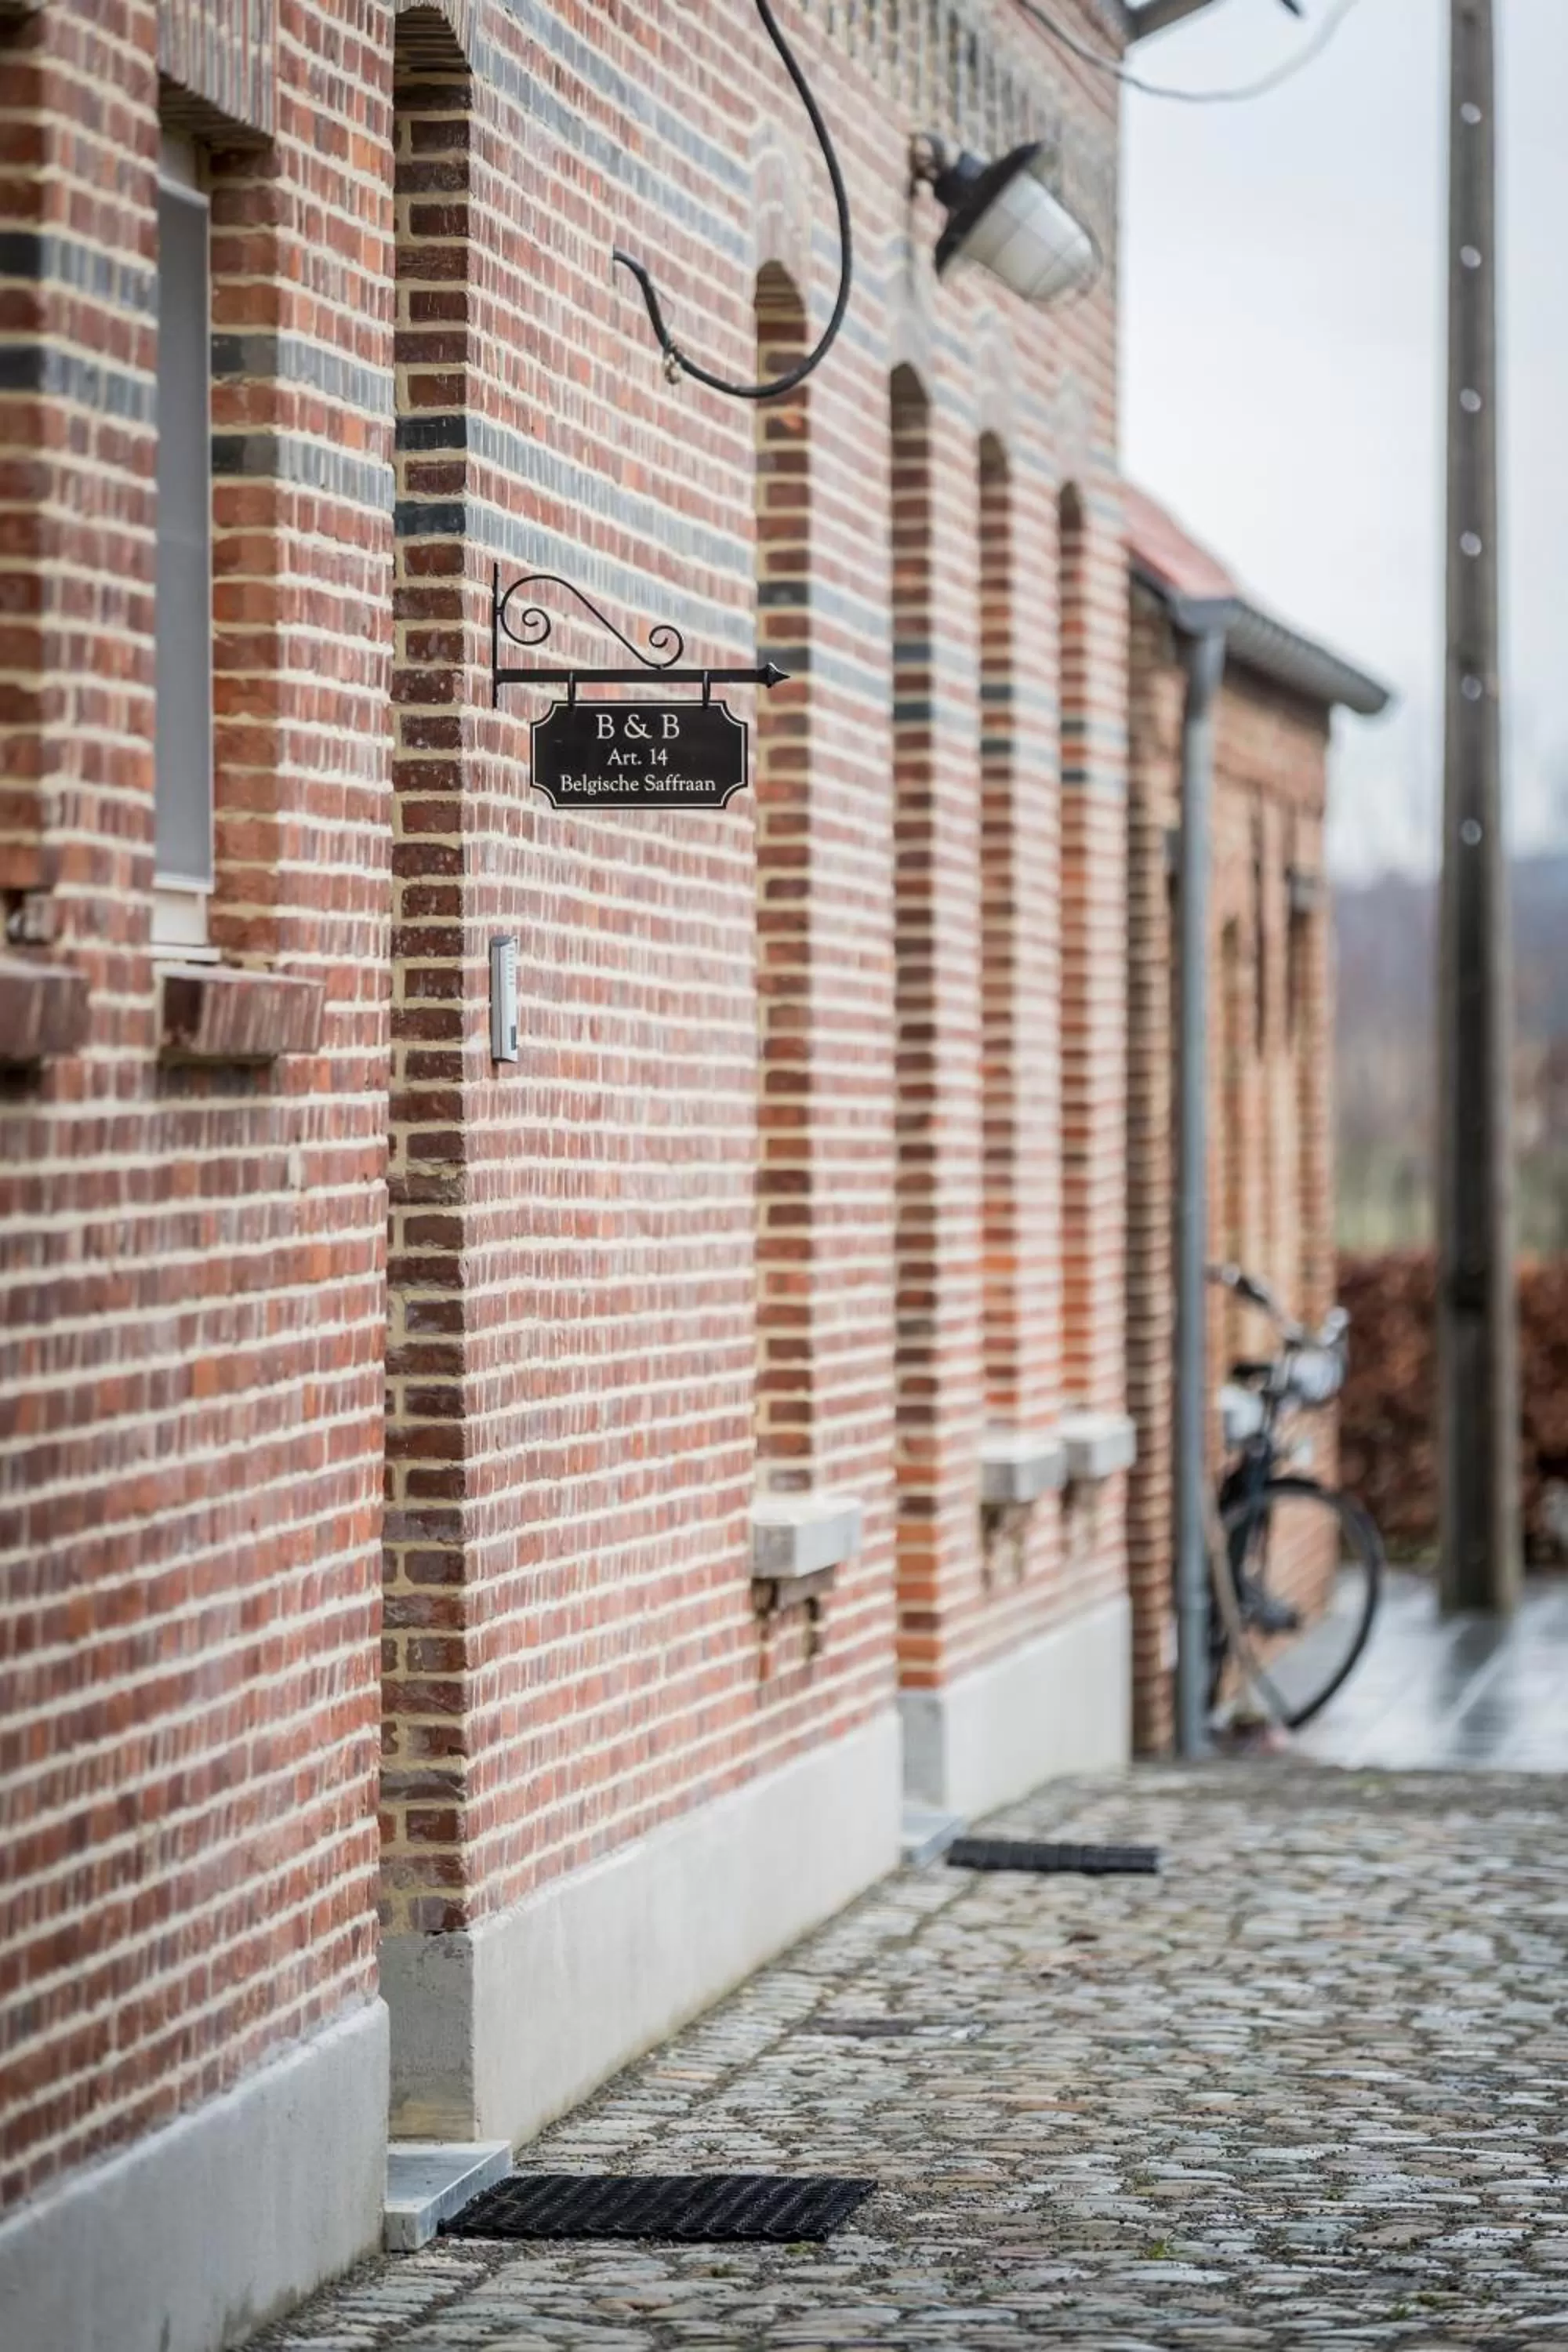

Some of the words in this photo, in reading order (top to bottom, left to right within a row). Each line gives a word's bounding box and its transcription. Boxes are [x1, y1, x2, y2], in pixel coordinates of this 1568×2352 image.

[596, 713, 615, 739] B
[623, 713, 653, 739] &
[662, 713, 680, 739] B
[606, 748, 642, 765] Art.
[650, 748, 668, 766] 14
[560, 774, 639, 795] Belgische
[644, 774, 716, 791] Saffraan
